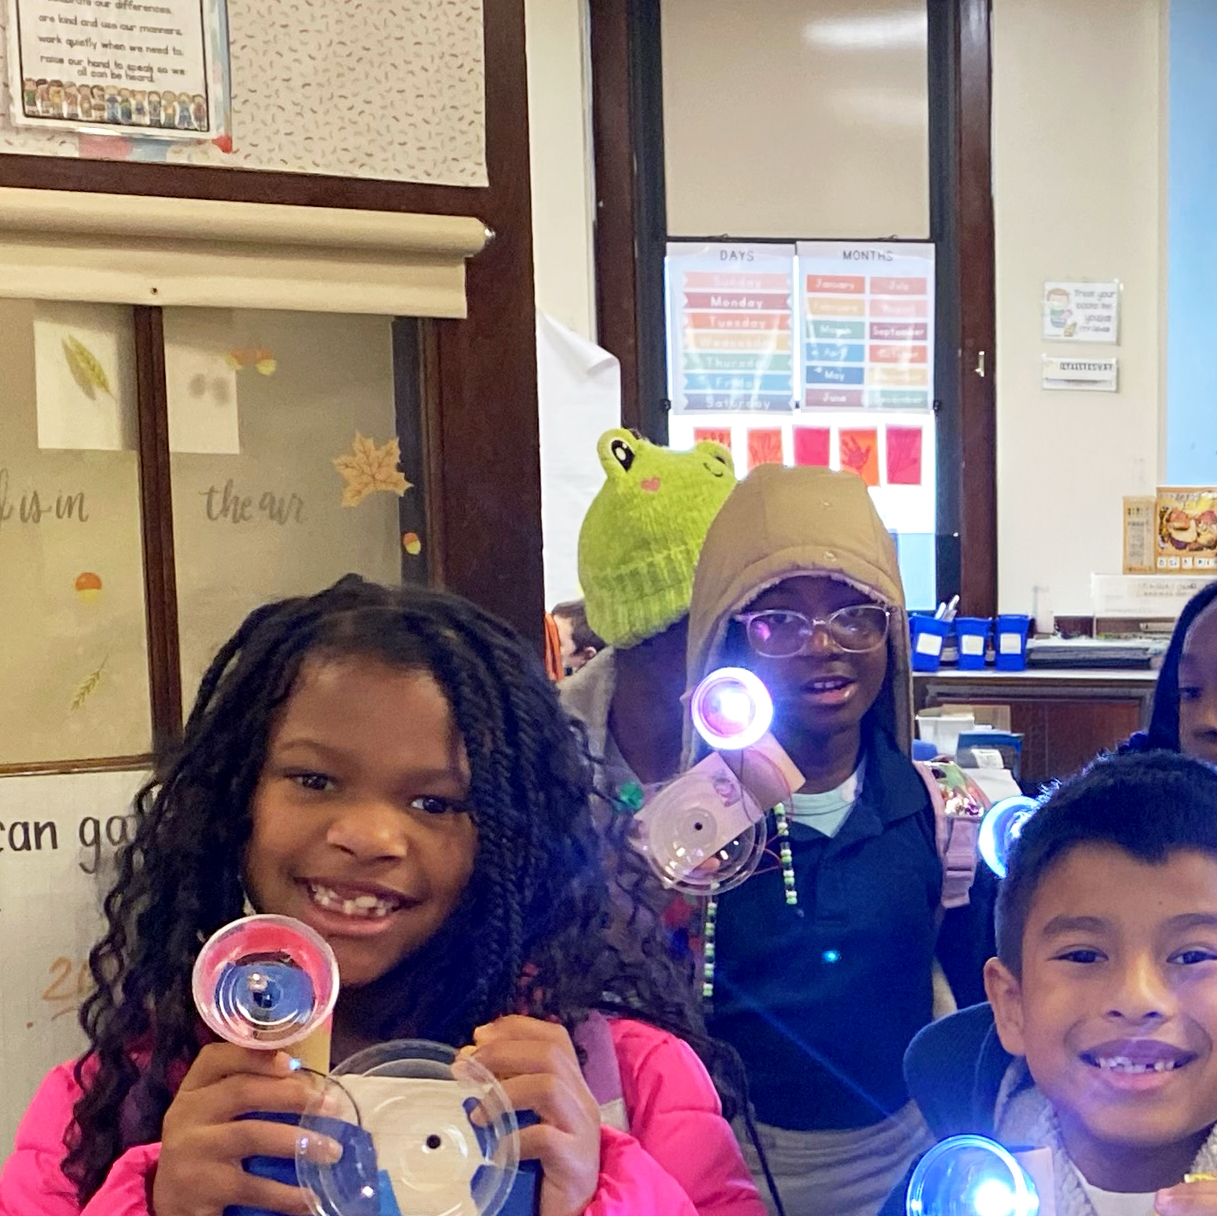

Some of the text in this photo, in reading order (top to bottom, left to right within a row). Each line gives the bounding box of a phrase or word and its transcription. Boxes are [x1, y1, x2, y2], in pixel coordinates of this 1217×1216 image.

[58, 14, 78, 26] kind
[80, 17, 98, 28] and
[38, 34, 62, 44] work
[66, 37, 98, 50] quietly
[100, 40, 126, 51] when
[129, 44, 143, 53] we
[146, 44, 169, 56] need
[68, 58, 84, 66] our
[86, 58, 110, 70] hand
[114, 60, 124, 70] to
[76, 66, 88, 77] all
[90, 70, 108, 78] can
[110, 70, 122, 80] be
[720, 250, 755, 262] DAYS
[842, 250, 894, 262] MONTHS
[814, 278, 855, 291] January
[710, 296, 764, 310] Monday
[708, 316, 766, 330] Tuesday
[872, 325, 926, 338] September
[824, 370, 845, 382] May
[706, 398, 771, 410] Saturday
[822, 392, 847, 404] June
[56, 489, 90, 522] in
[198, 478, 255, 524] the
